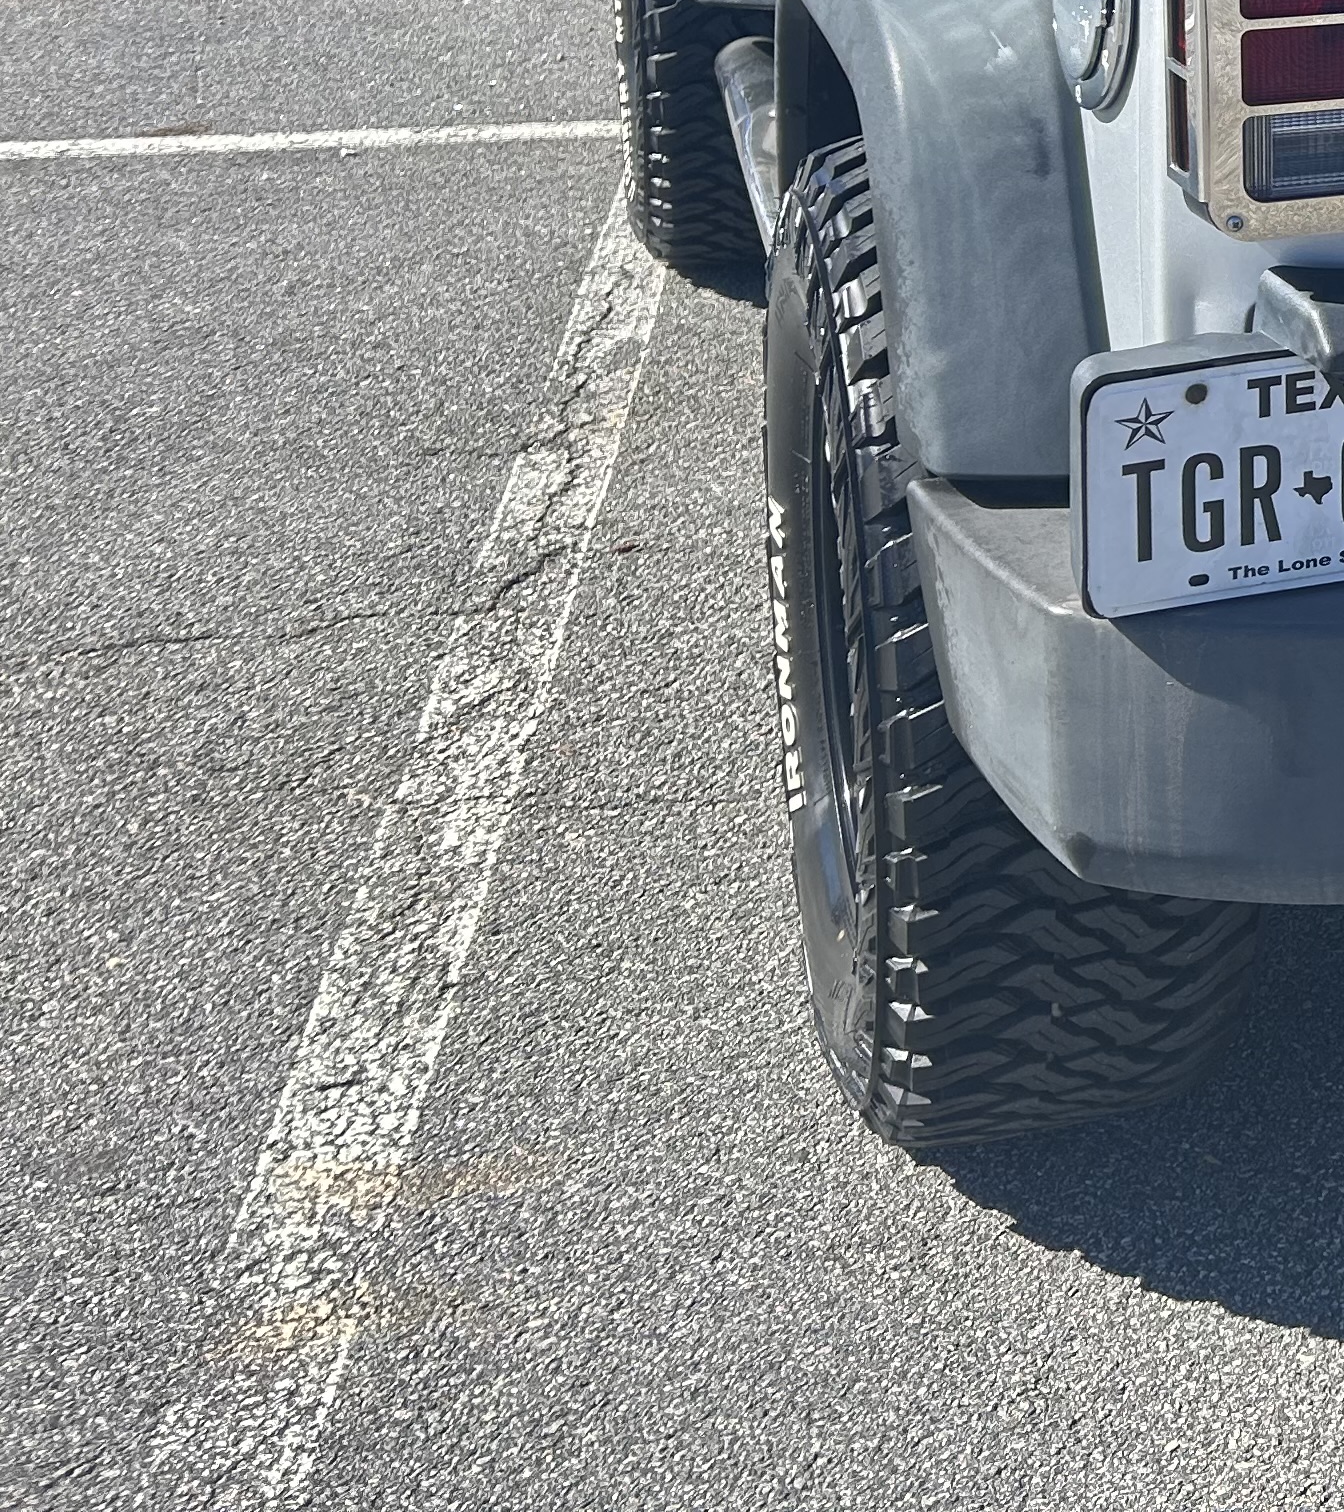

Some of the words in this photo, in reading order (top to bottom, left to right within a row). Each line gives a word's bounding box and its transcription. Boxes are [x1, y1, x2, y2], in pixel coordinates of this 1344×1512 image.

[1121, 444, 1282, 563] TGR
[1228, 565, 1270, 580] The
[1278, 555, 1331, 573] Lone
[767, 496, 806, 813] IRONMAN
